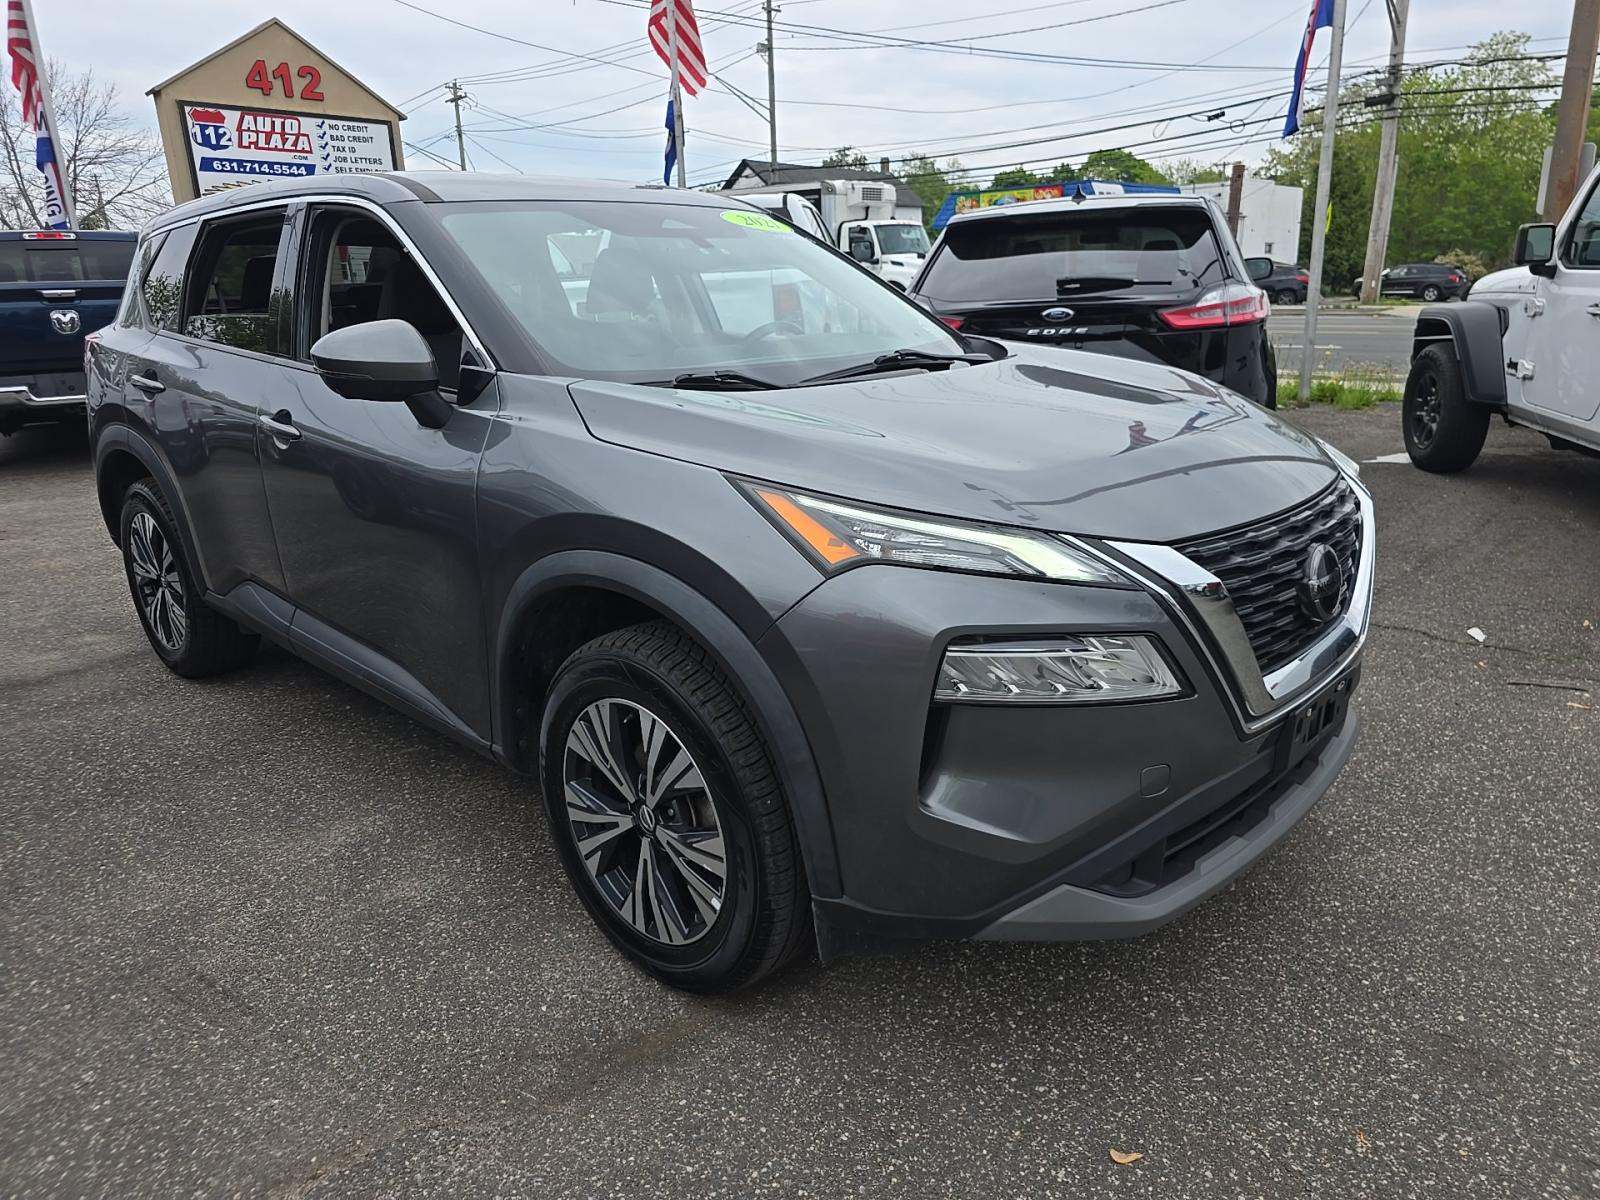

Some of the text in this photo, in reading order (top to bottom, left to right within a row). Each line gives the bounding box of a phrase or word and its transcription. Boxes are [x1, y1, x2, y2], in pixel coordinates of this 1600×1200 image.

[246, 60, 324, 101] 412
[241, 114, 299, 134] AUTO
[341, 124, 369, 133] CREDIT
[191, 125, 233, 146] 112
[242, 131, 312, 151] PLAZA
[330, 134, 374, 144] BAD CREDIT
[331, 145, 357, 154] TAX ID
[213, 160, 307, 175] 631.714.5544
[333, 155, 383, 165] JOB LETTERS
